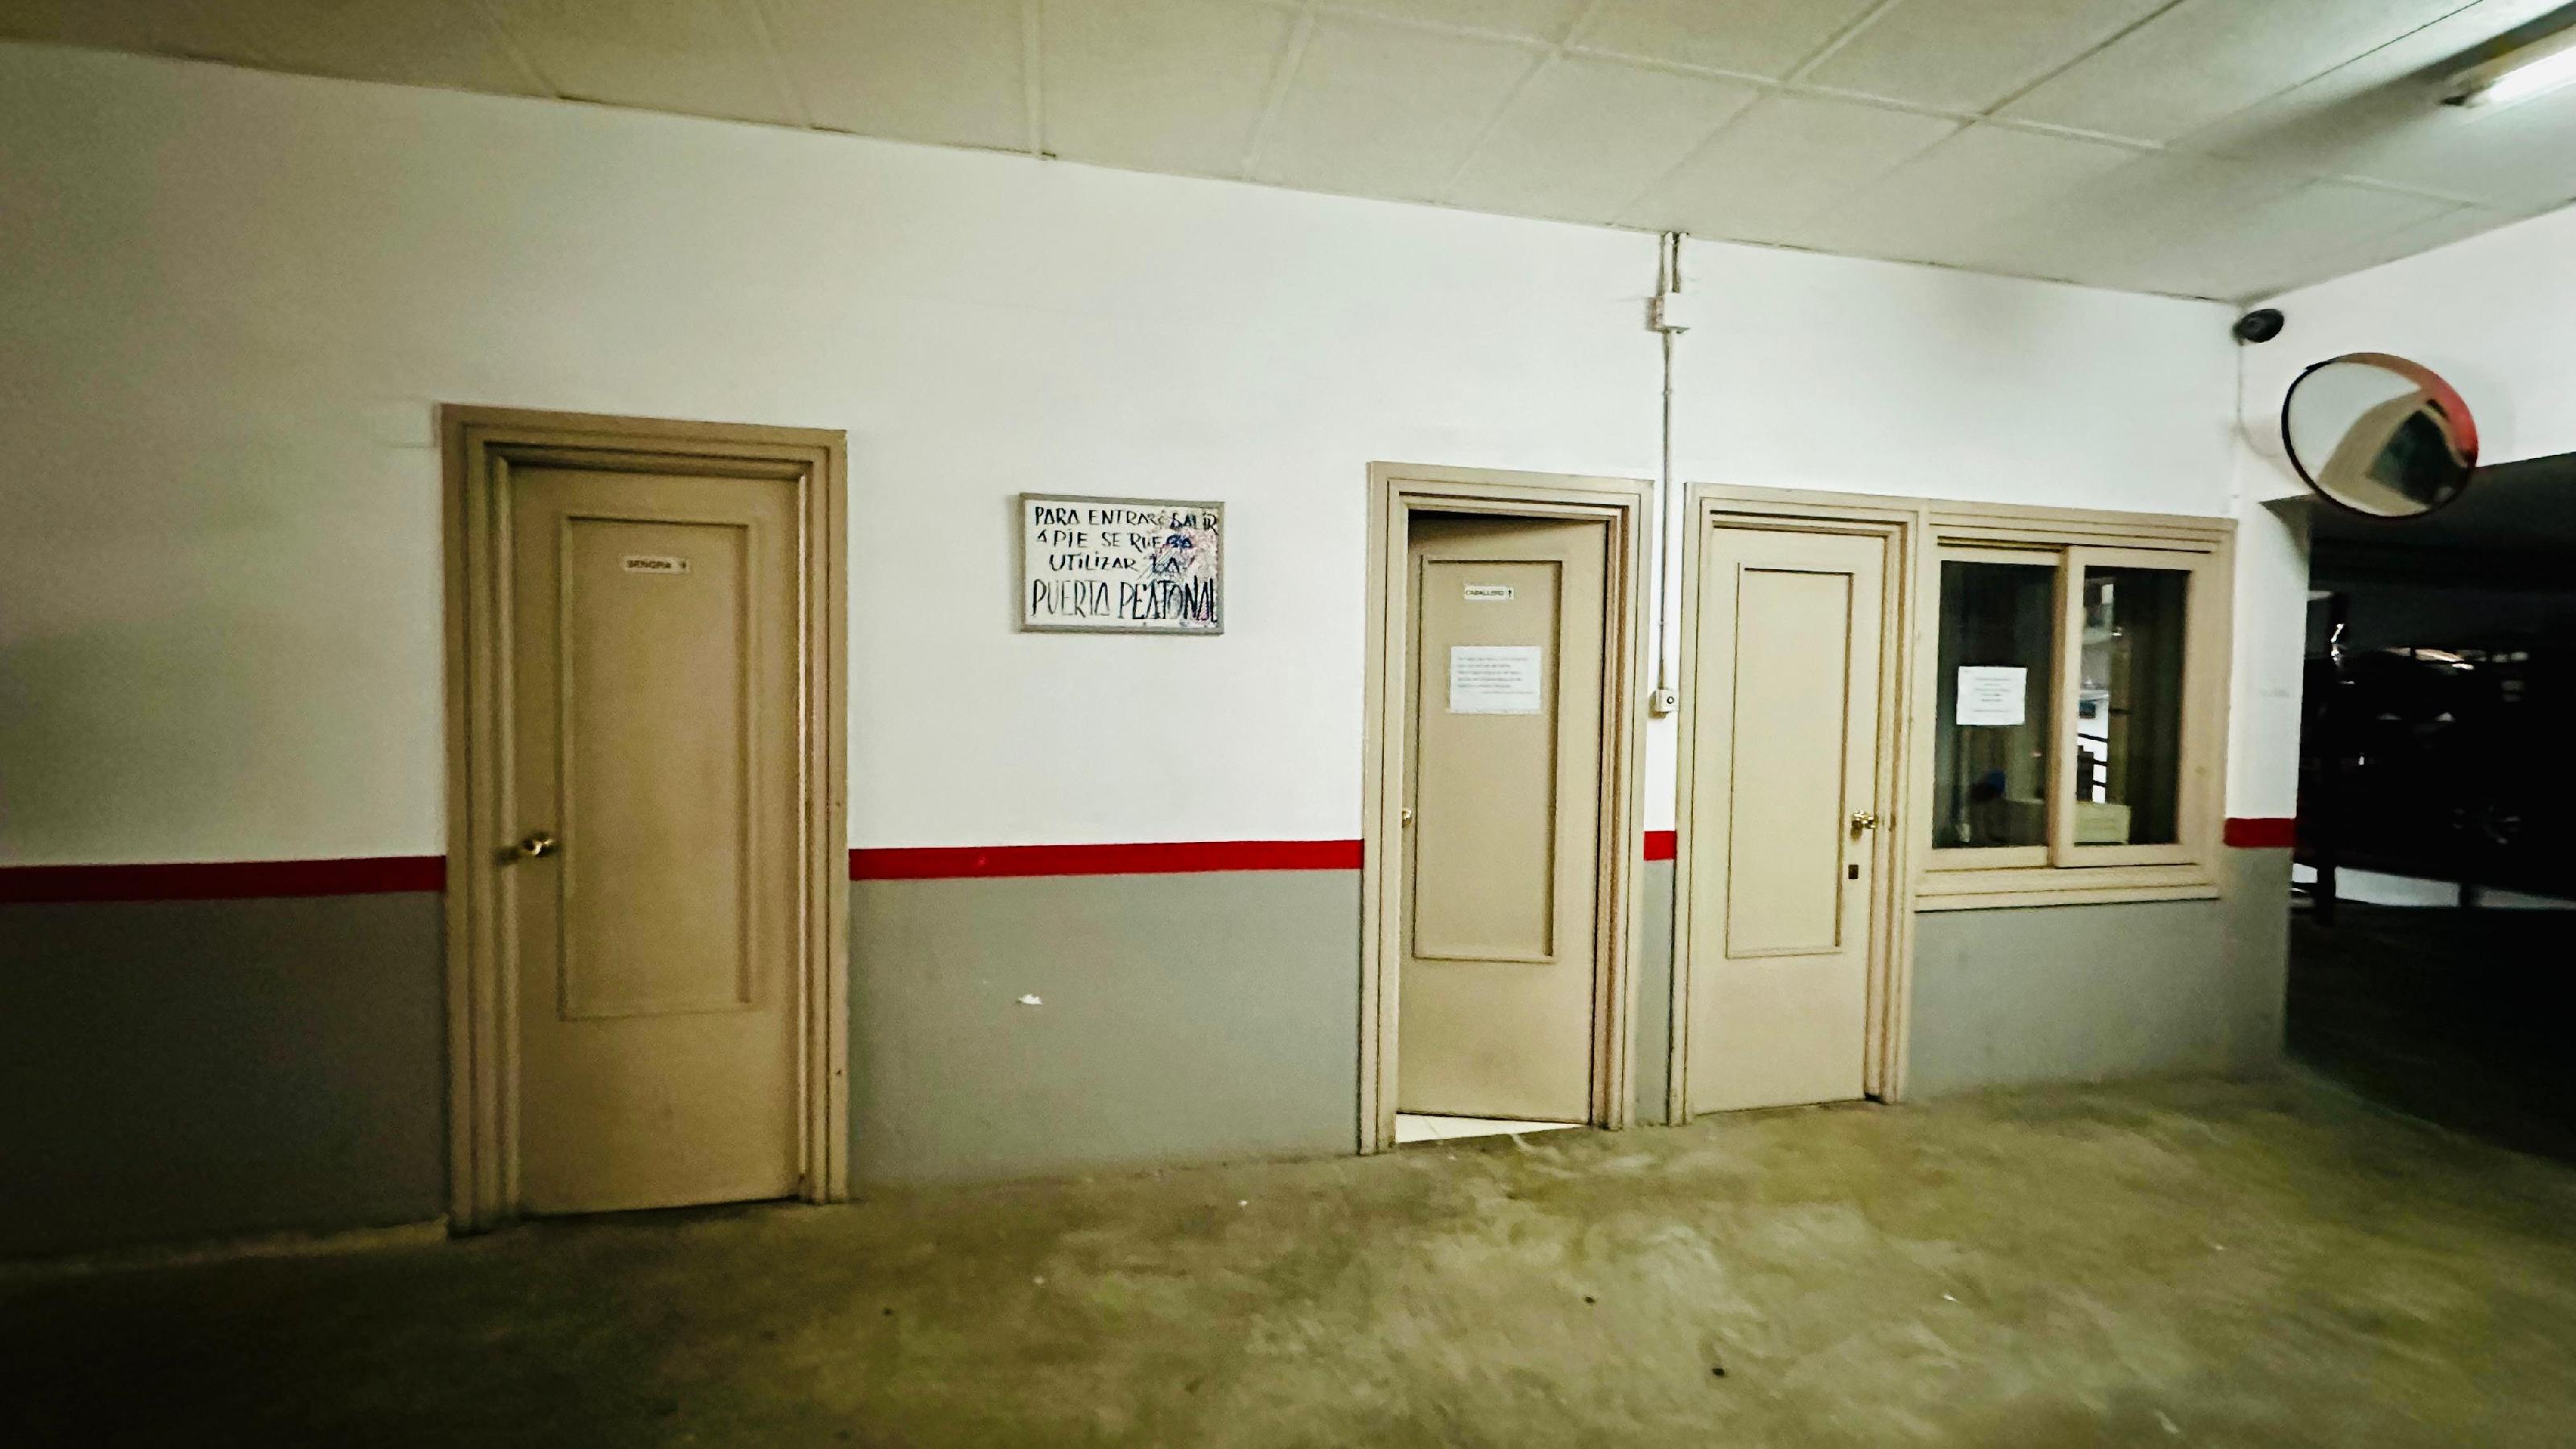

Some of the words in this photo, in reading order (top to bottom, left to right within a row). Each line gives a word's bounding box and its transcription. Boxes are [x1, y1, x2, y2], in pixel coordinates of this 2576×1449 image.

[1035, 506, 1080, 526] PARA
[1088, 510, 1157, 526] ENTRAR
[1054, 528, 1088, 548] PIE
[1102, 531, 1120, 548] SE
[1151, 554, 1180, 573] LA
[1031, 578, 1110, 618] PUERTA
[1118, 575, 1218, 623] PEATONAL
